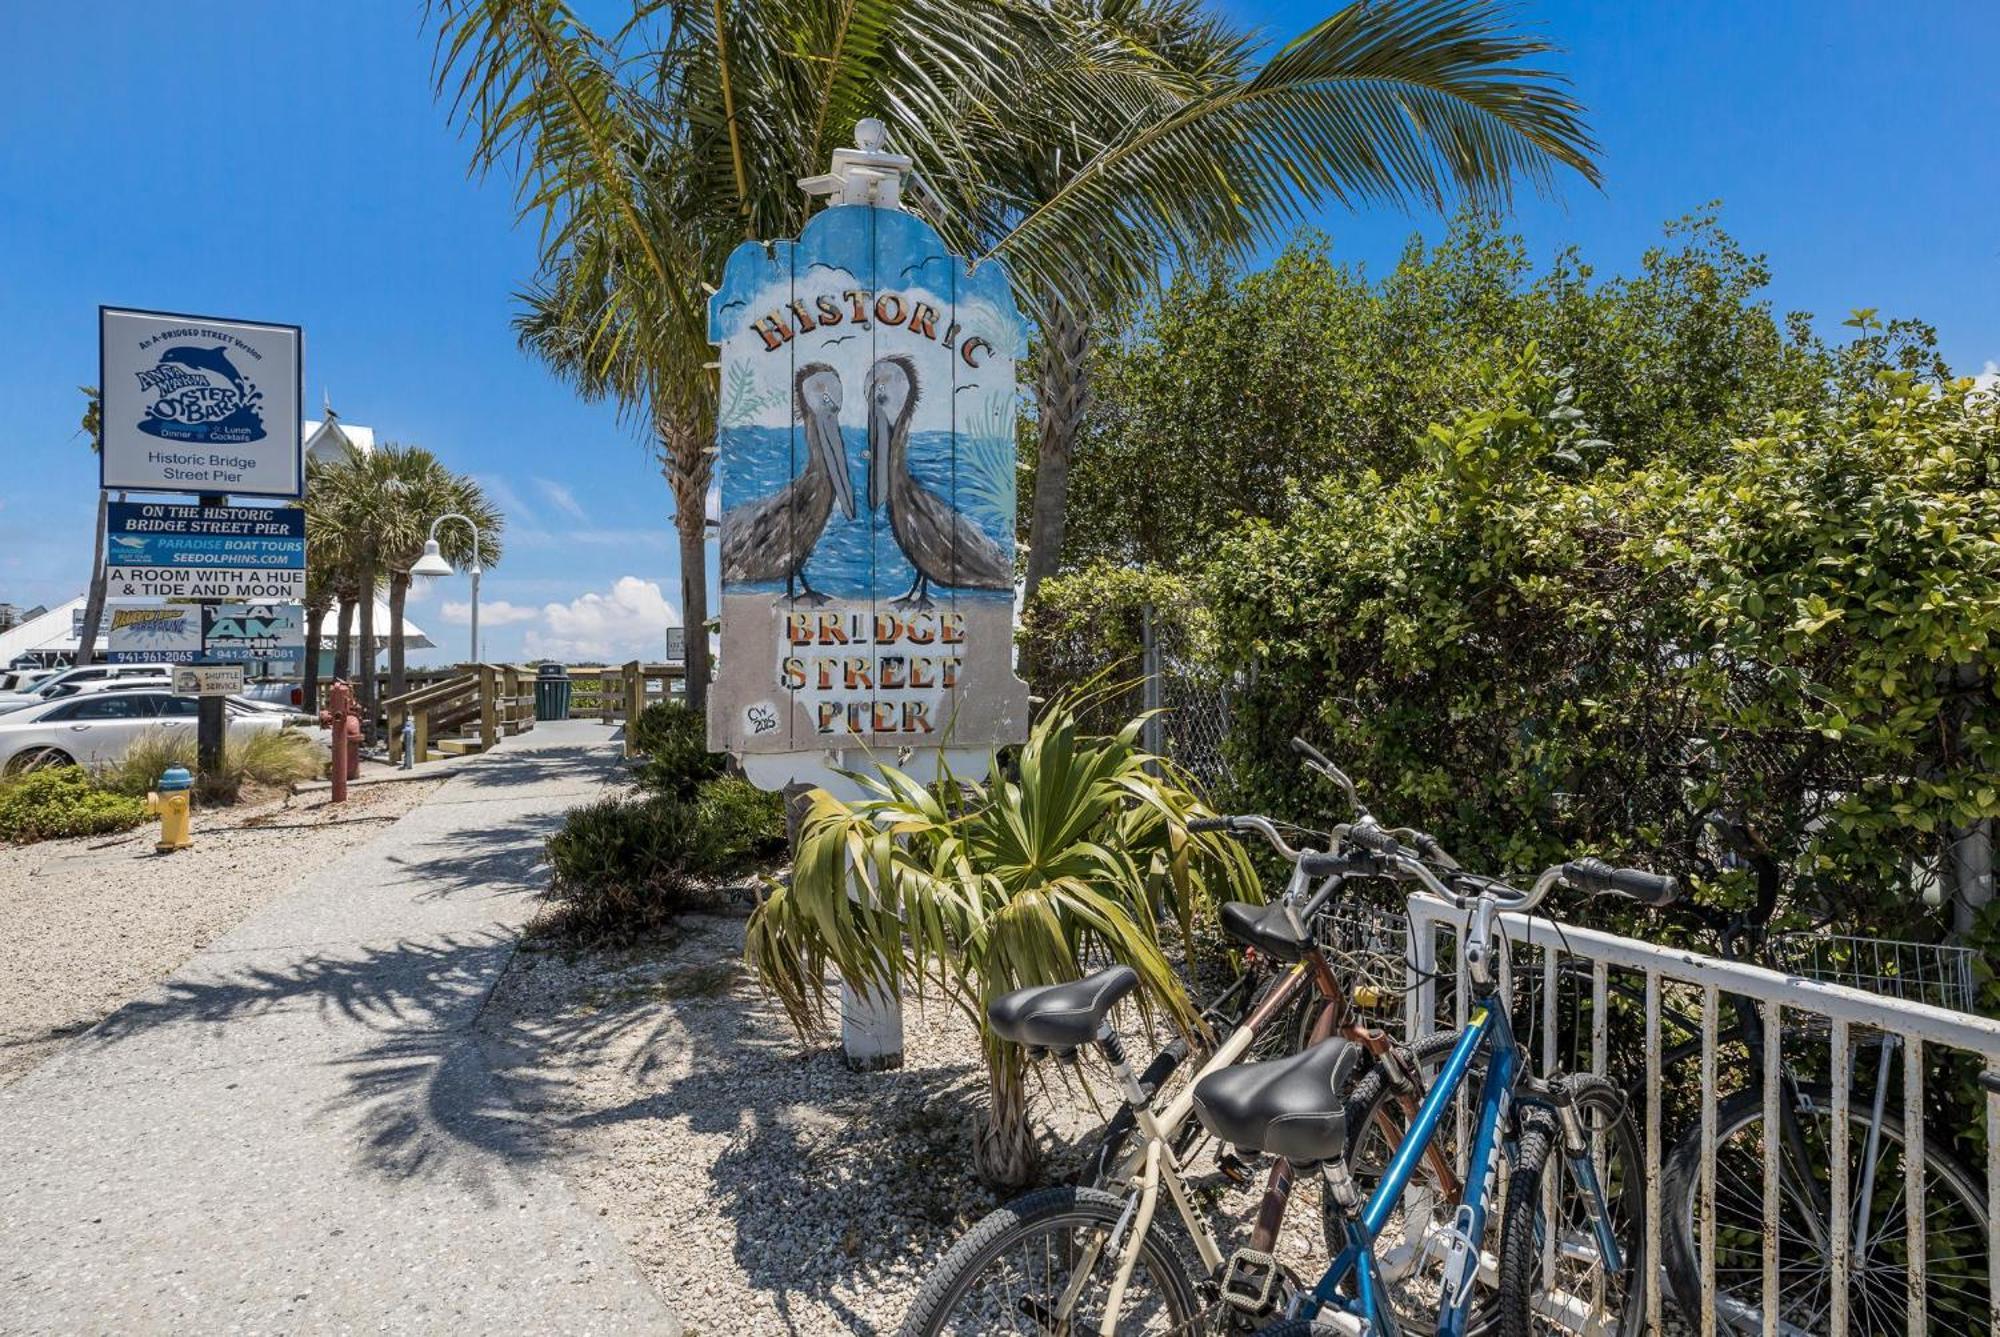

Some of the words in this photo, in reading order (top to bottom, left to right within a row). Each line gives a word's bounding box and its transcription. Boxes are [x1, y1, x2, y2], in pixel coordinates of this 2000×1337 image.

[750, 289, 996, 369] HISTORIC
[200, 330, 234, 343] STREET
[234, 338, 262, 360] Version
[135, 364, 187, 392] ANNA
[157, 375, 211, 398] MARIA
[153, 388, 236, 418] OYSTER
[186, 401, 234, 422] BAR
[161, 429, 191, 438] Dinner
[148, 452, 205, 465] Historic
[209, 454, 256, 469] Bridge
[163, 467, 208, 481] Street
[213, 470, 243, 482] Pier
[142, 505, 163, 517] ON
[170, 506, 199, 518] THE
[203, 508, 274, 521] HISTORIC
[125, 519, 187, 532] BRIDGE
[190, 522, 251, 534] STREET
[254, 523, 290, 535] PIER
[157, 539, 223, 550] PARADISE
[224, 540, 258, 551] BOAT
[261, 541, 301, 551] TOURS
[173, 553, 288, 564] SEEDOLPHINS.COM
[111, 569, 124, 581] A
[131, 570, 190, 581] ROOM
[194, 571, 243, 582] WITH
[249, 571, 263, 582] A
[267, 572, 304, 583] HUE
[123, 584, 135, 595] &
[142, 584, 185, 596] TIDE
[190, 584, 230, 596] AND
[236, 585, 292, 597] MOON
[787, 612, 967, 646] BRIDGE
[118, 651, 193, 663] 941-961-2065
[781, 656, 964, 690] STREET
[206, 682, 238, 690] SERVICE
[817, 701, 936, 734] PIER
